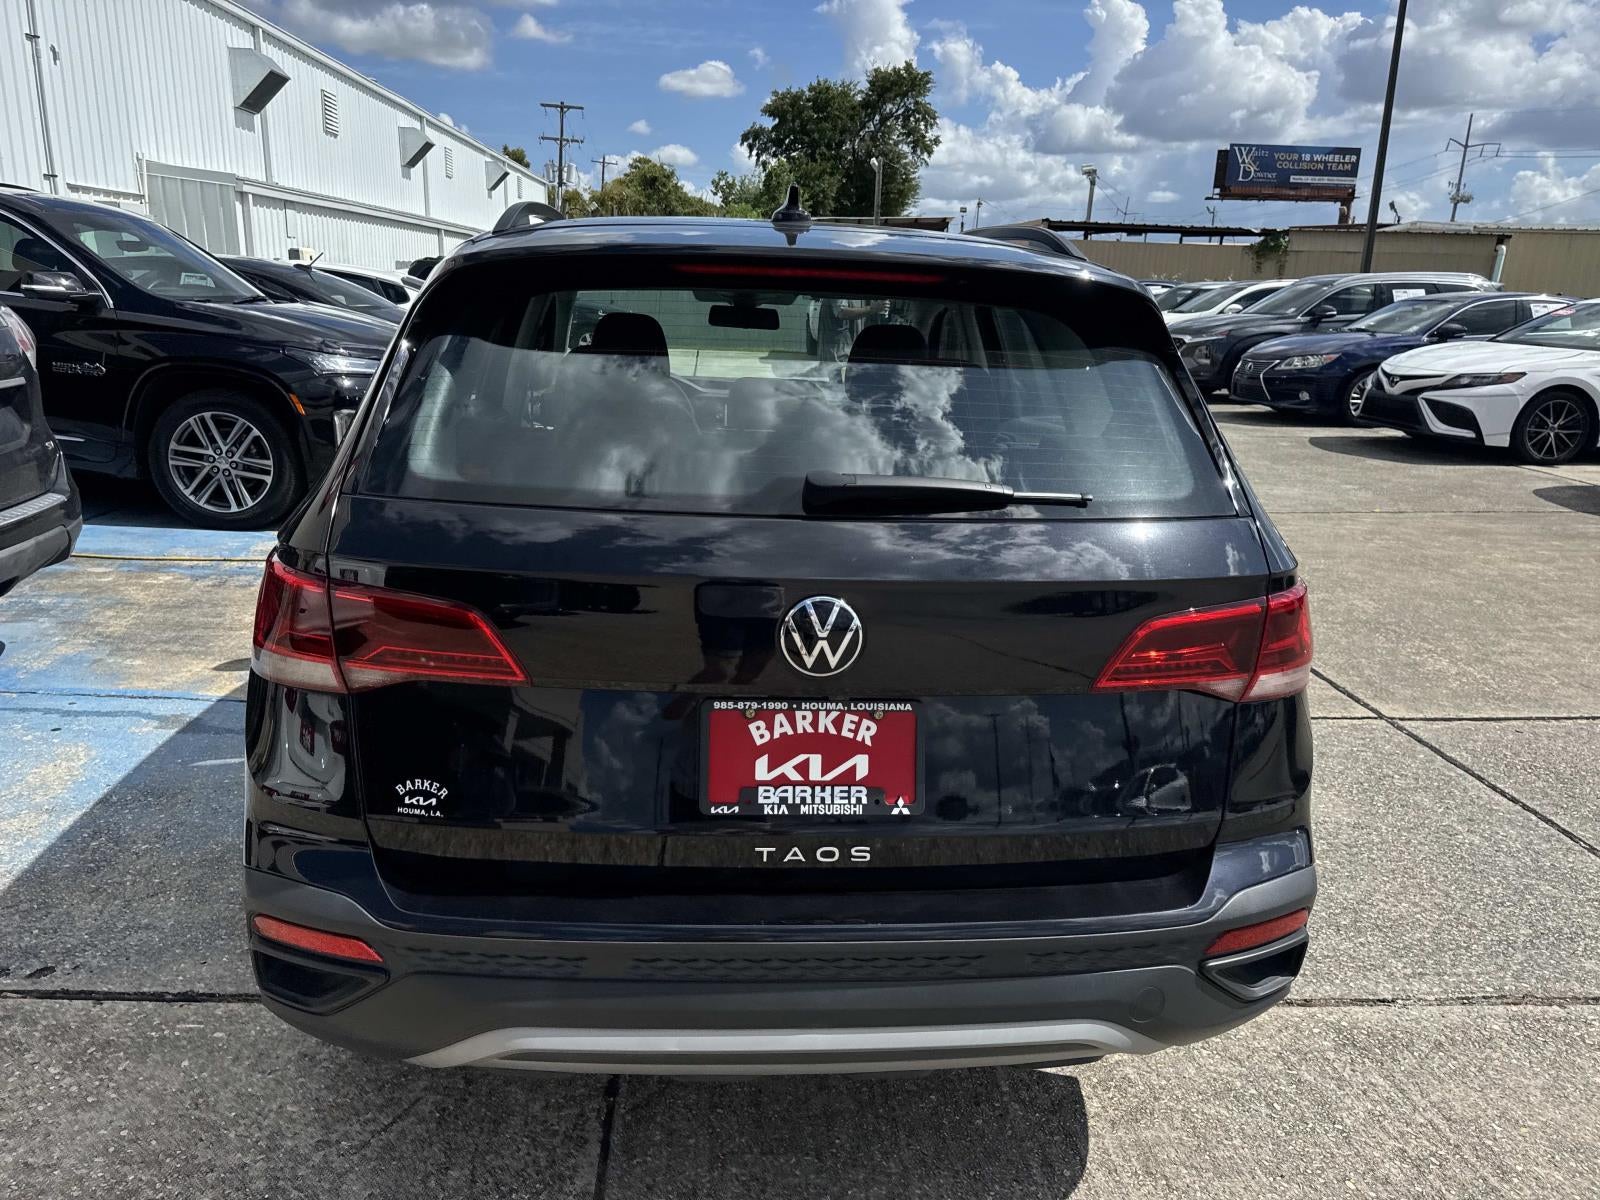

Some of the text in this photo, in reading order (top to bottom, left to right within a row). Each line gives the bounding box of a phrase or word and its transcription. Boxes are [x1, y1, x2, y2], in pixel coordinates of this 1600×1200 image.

[1235, 147, 1268, 164] Waitz
[1274, 152, 1357, 163] YOUR 18 WHEELER
[1238, 164, 1277, 181] Downer
[1276, 161, 1351, 171] COLLISION TEAM
[713, 701, 913, 711] 985-879-1990 HOUMA, LOUISIANA
[748, 710, 878, 746] BARKER
[755, 753, 869, 781] KIA
[395, 778, 449, 800] BARKER
[397, 806, 429, 817] HOUMA,
[763, 804, 863, 815] KIA MITSUBISHI
[754, 846, 871, 862] TAOS
